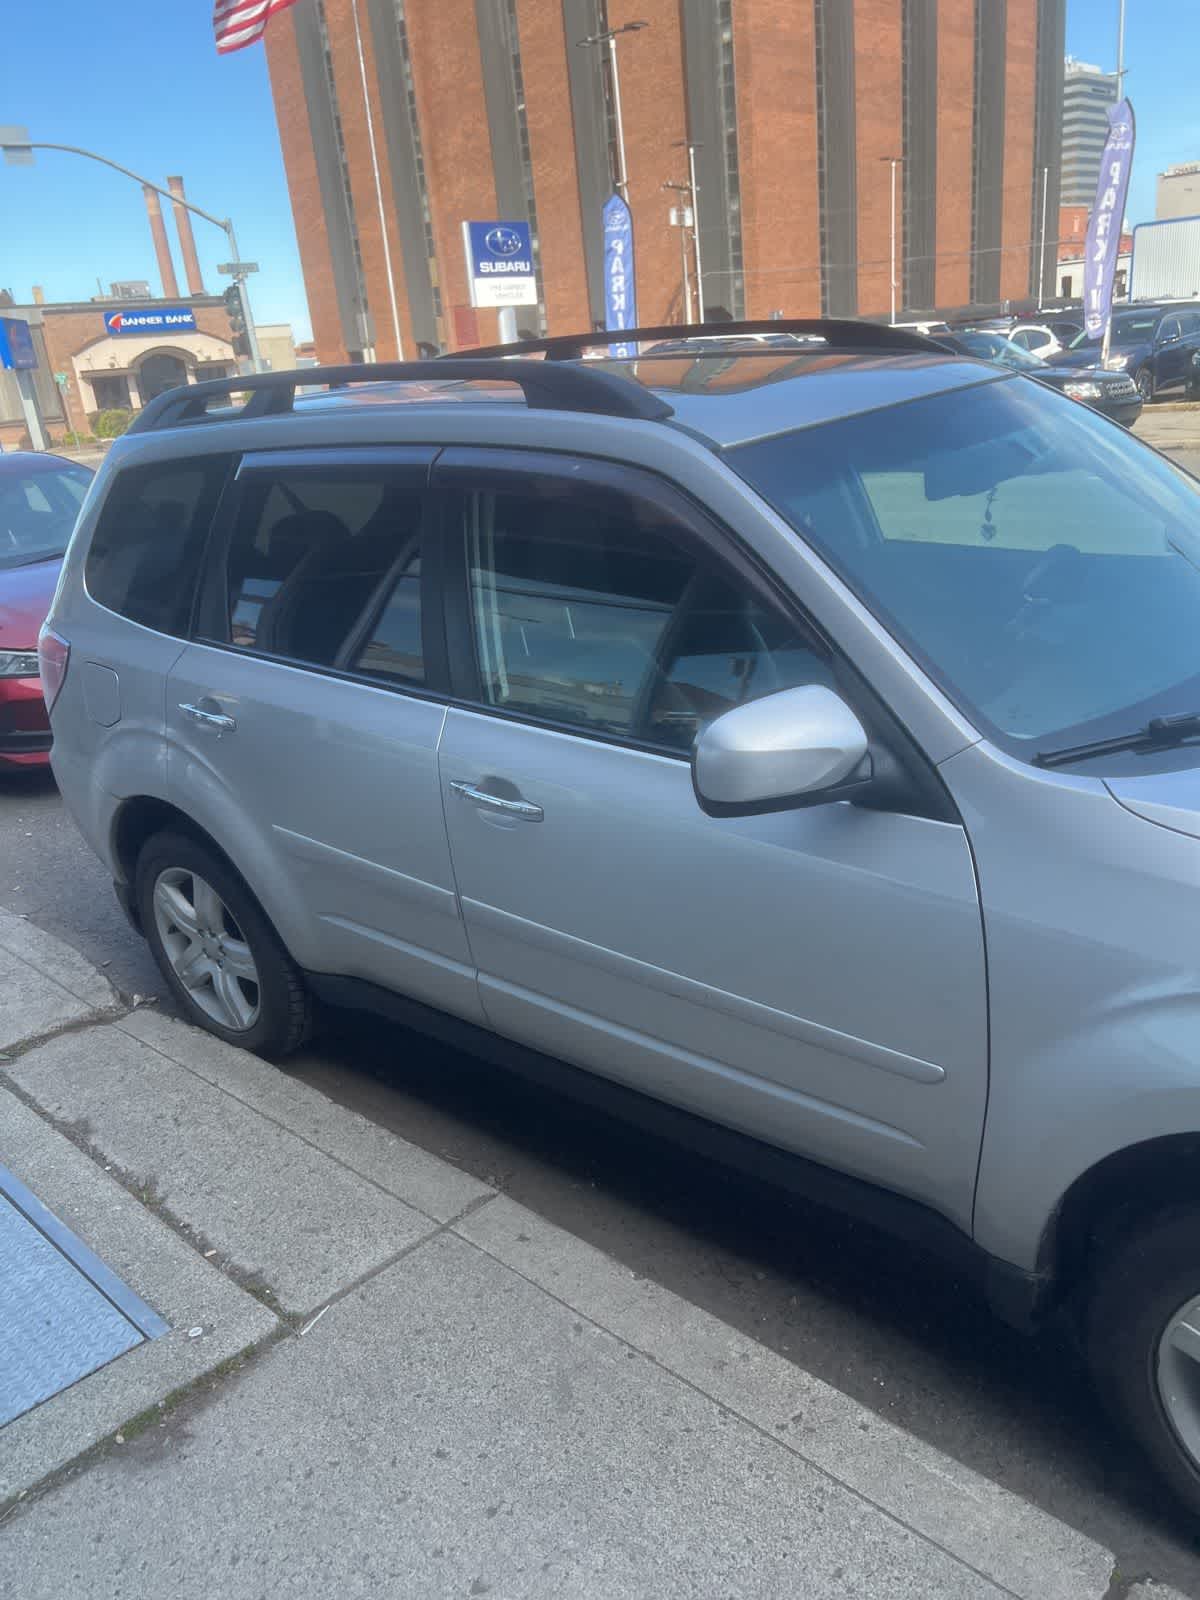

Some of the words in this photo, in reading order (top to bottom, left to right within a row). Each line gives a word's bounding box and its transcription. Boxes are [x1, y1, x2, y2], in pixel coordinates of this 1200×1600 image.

[479, 261, 531, 273] SUBARU
[120, 316, 162, 326] BANNER
[165, 314, 194, 324] BANK
